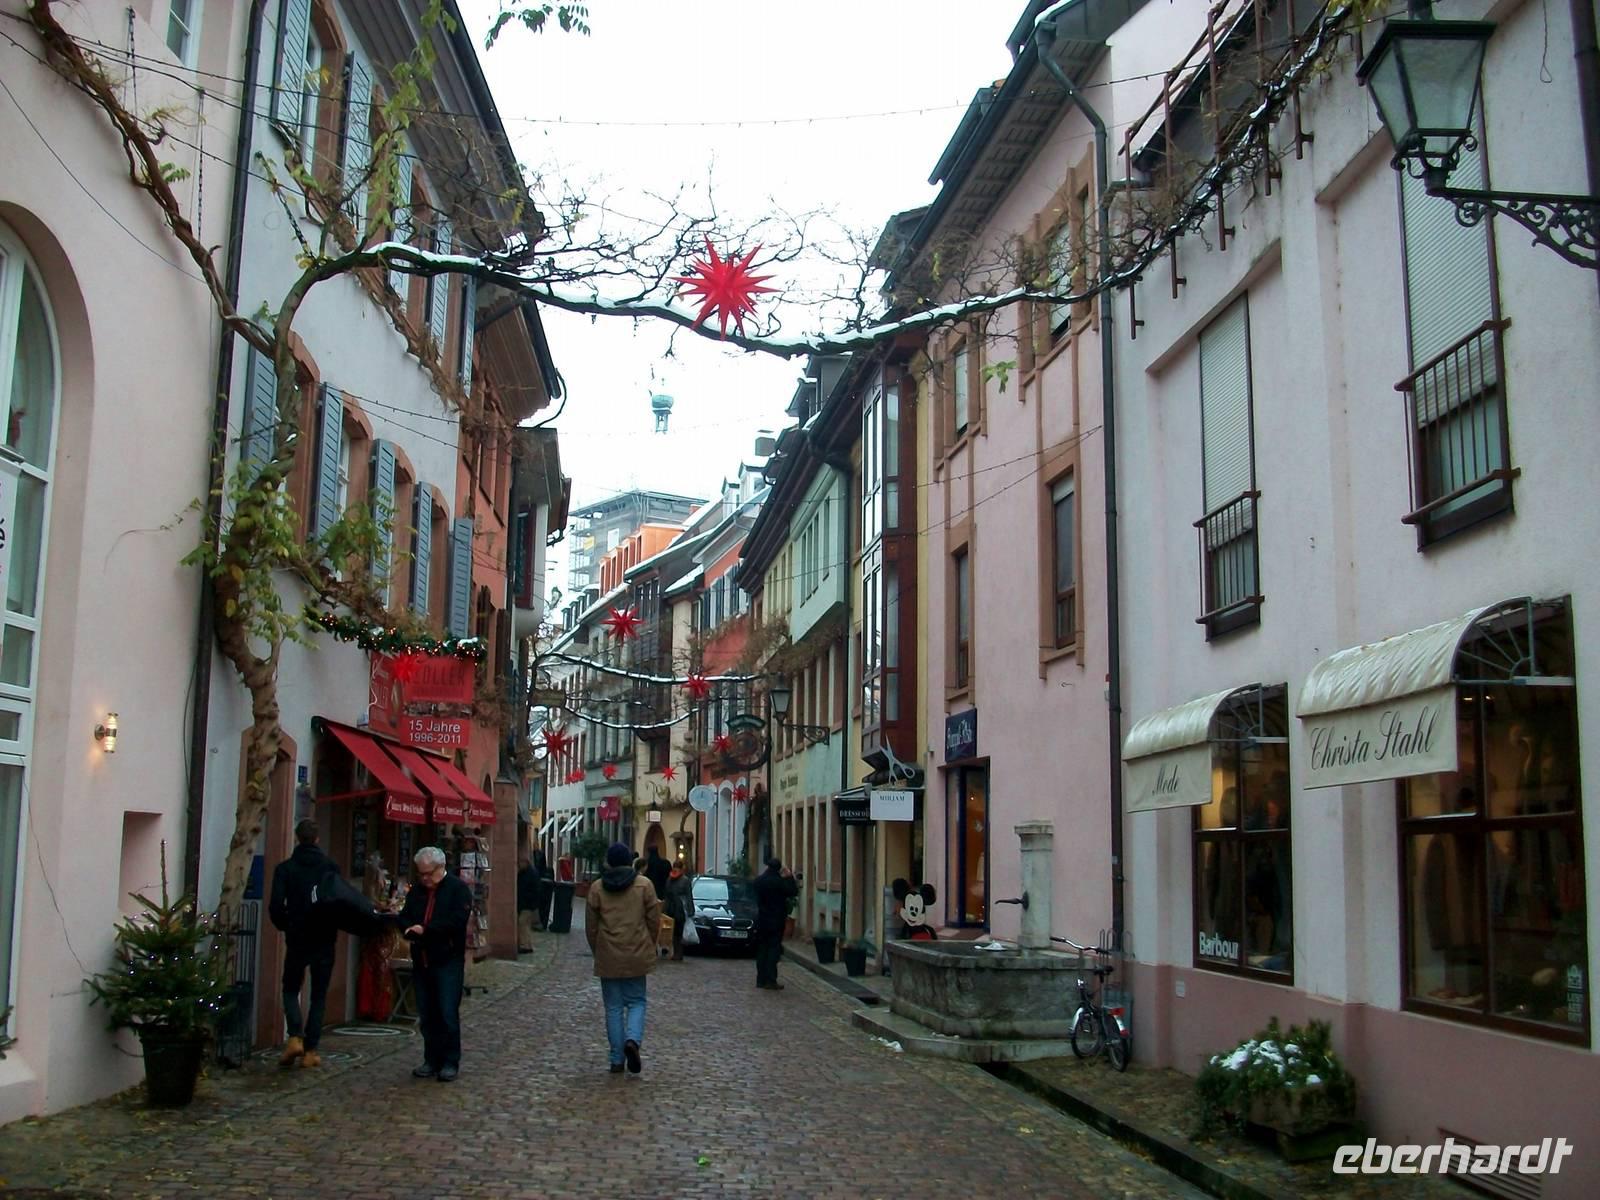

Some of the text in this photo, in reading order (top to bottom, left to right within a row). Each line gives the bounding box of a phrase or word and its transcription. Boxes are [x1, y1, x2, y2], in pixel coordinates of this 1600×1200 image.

[408, 719, 461, 733] 15 Jahre
[408, 732, 462, 745] 1996-2011
[1311, 705, 1441, 771] Christa Stahl
[1151, 763, 1181, 796] Mode
[1198, 931, 1239, 961] Barbour
